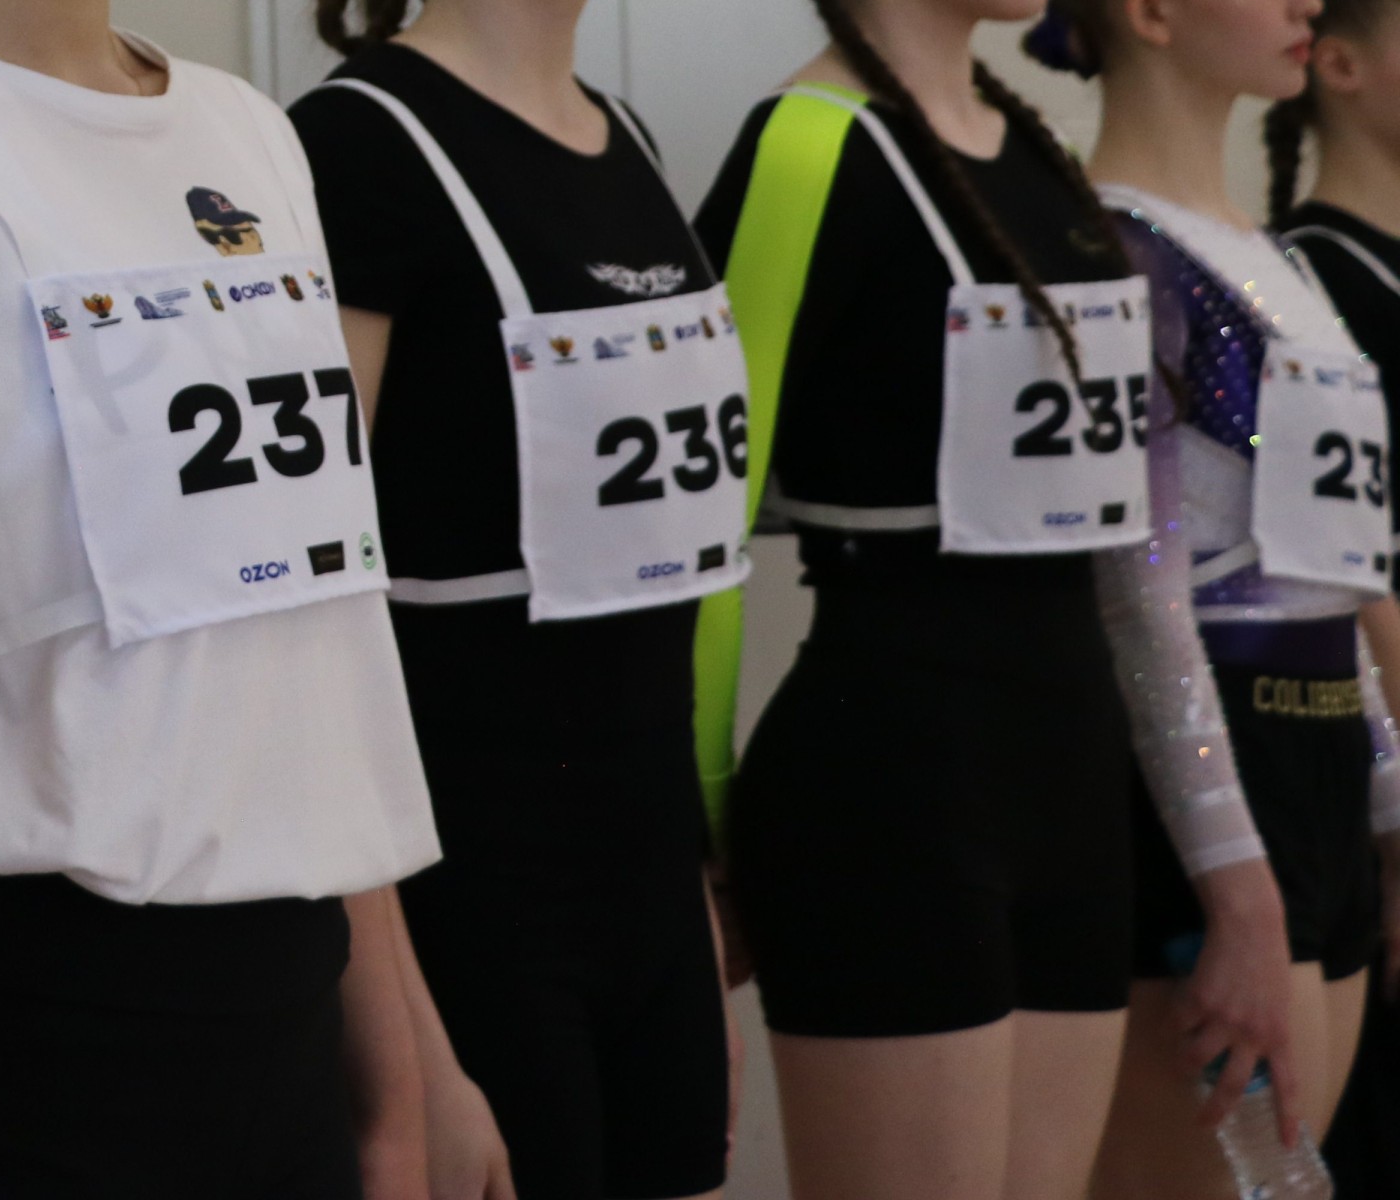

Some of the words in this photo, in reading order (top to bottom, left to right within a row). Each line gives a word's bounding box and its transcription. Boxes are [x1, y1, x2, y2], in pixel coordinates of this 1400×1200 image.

[167, 367, 363, 495] 237
[595, 393, 748, 507] 236
[239, 559, 291, 584] OZON
